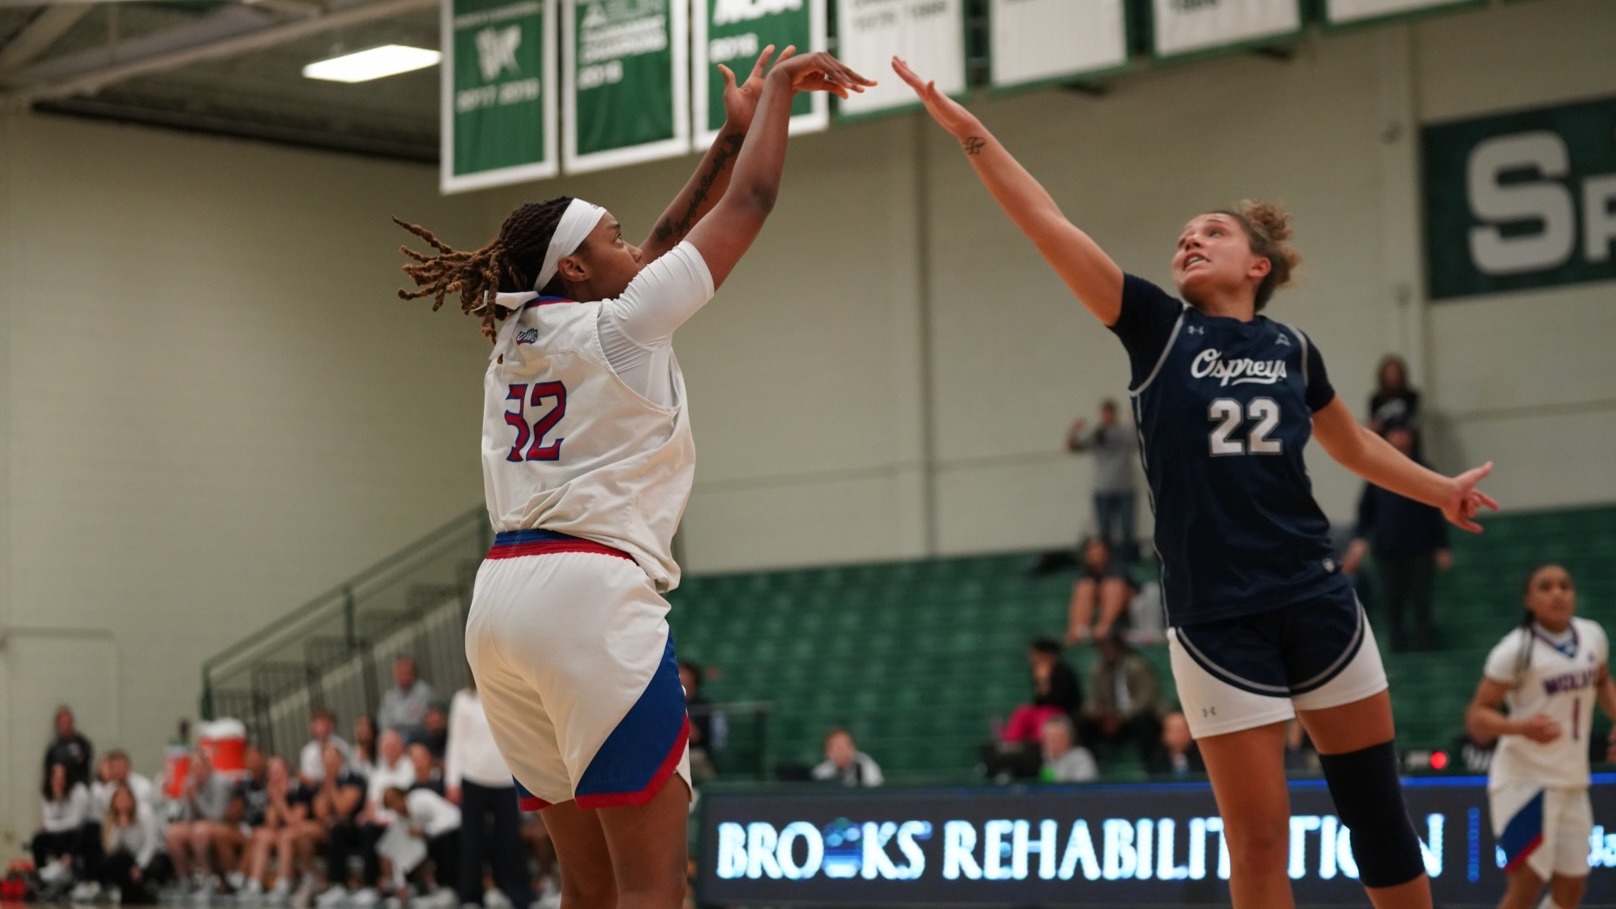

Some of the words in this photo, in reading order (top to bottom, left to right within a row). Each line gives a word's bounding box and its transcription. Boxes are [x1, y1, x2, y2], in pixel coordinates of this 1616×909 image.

[1191, 348, 1288, 387] Ospreys
[1208, 396, 1283, 456] 22
[716, 820, 932, 880] BROKS
[943, 813, 1443, 880] REHABILITTIN
